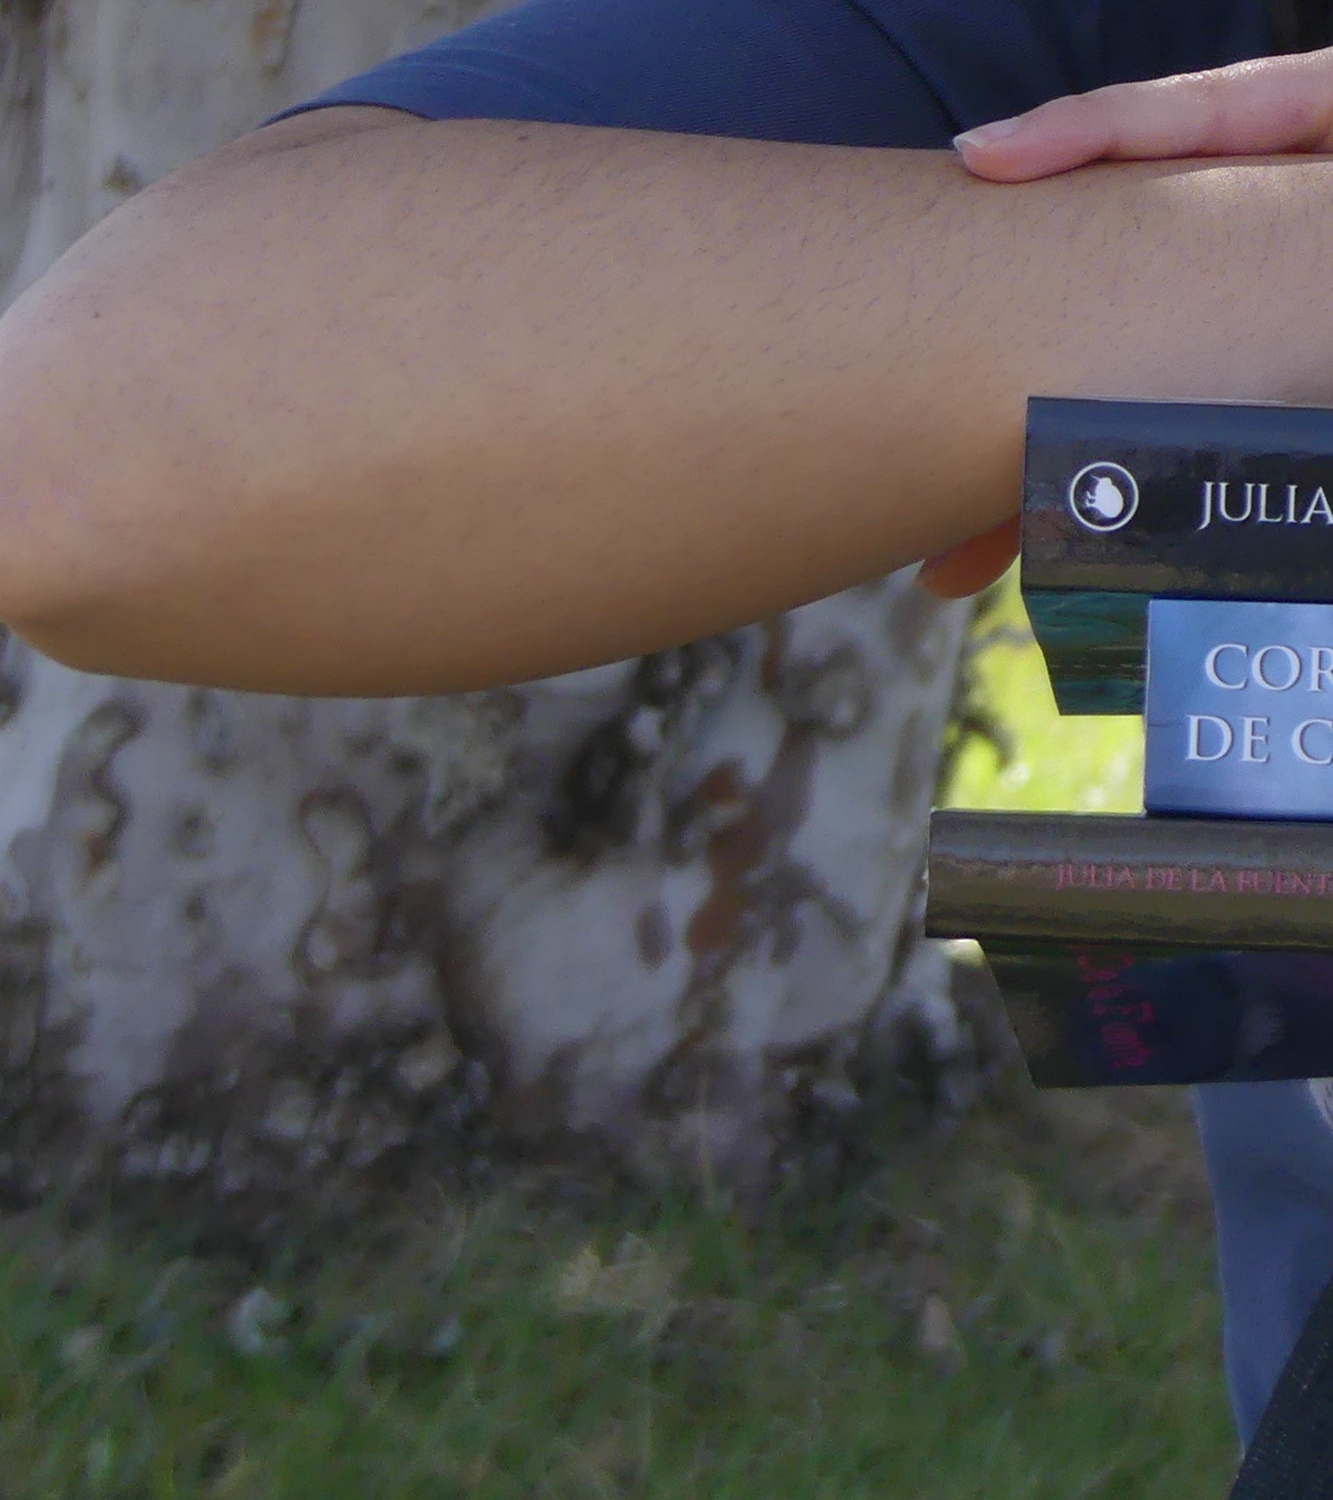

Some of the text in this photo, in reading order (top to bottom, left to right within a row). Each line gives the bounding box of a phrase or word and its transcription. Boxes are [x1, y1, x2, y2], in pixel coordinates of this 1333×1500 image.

[1185, 714, 1270, 763] DE
[1056, 864, 1137, 891] JULIA
[1190, 868, 1227, 893] LA
